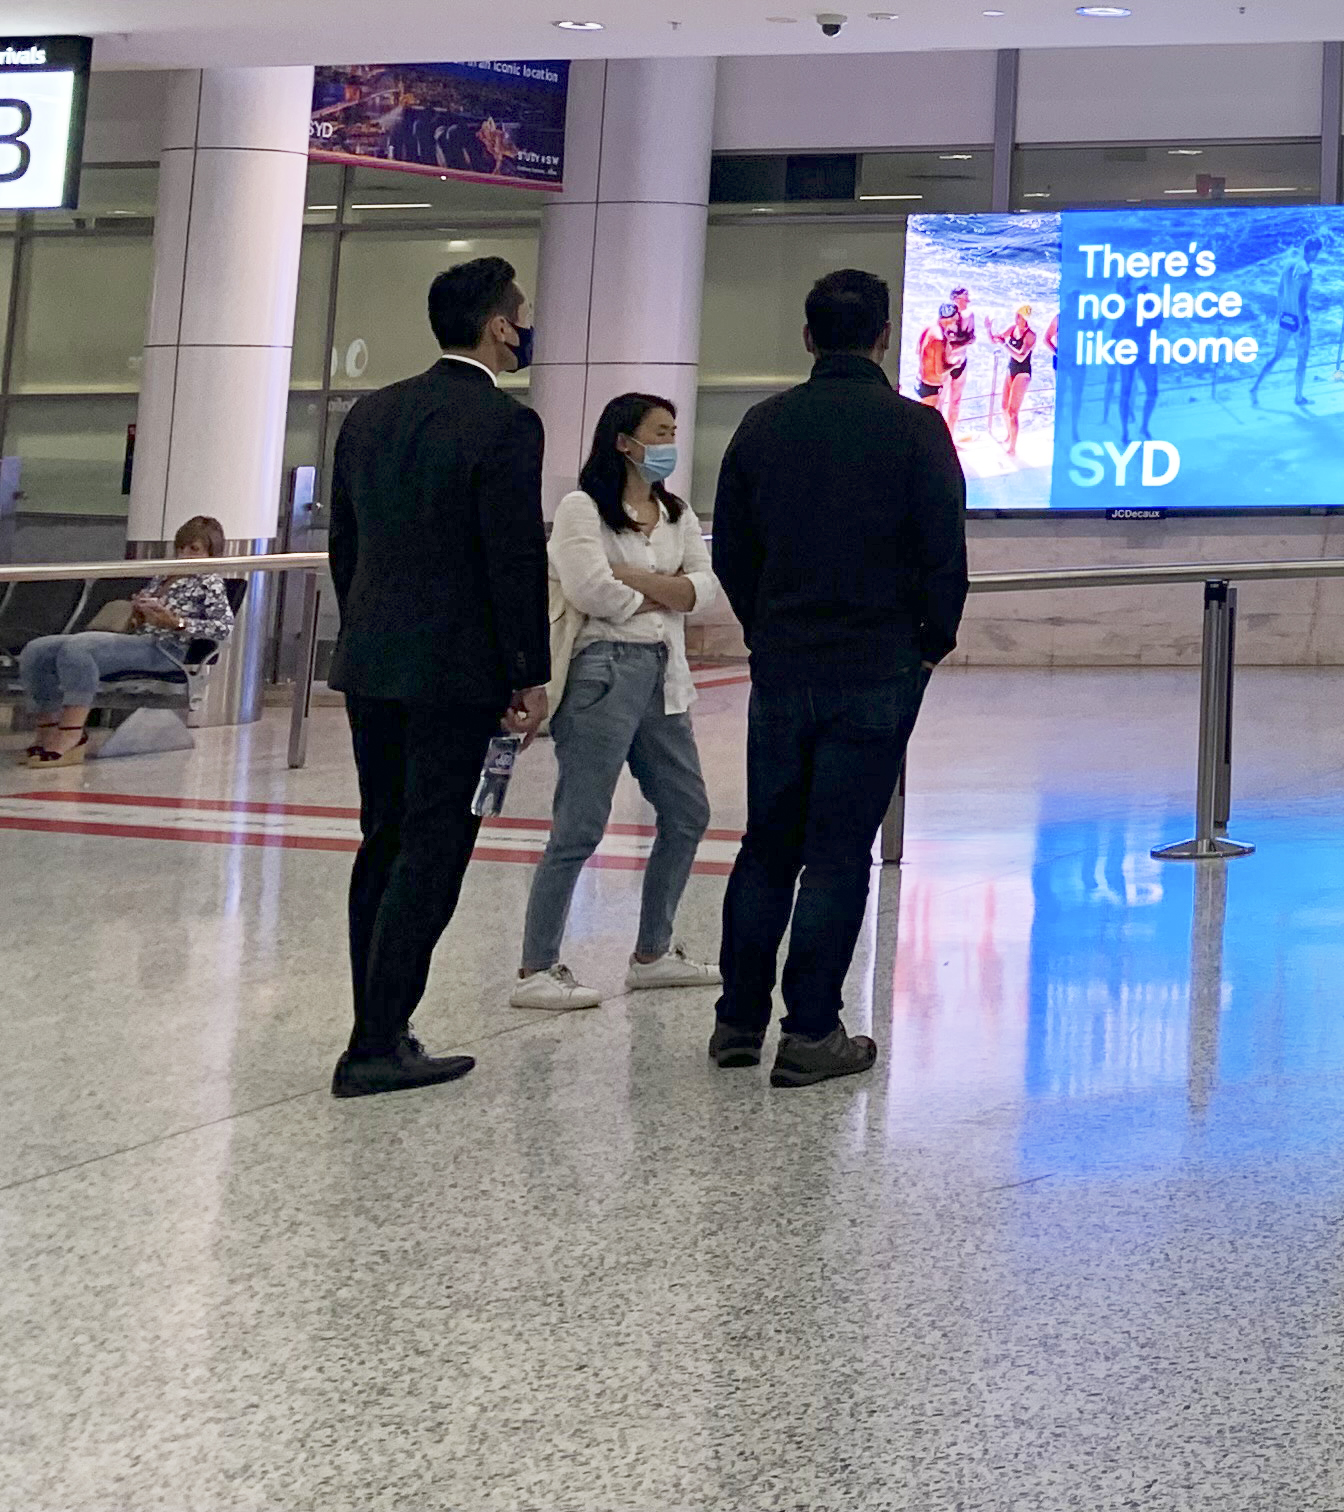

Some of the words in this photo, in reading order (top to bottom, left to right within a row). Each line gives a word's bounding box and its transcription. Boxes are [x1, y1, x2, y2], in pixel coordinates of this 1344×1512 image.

[0, 46, 47, 64] rivals
[523, 64, 558, 83] location
[1078, 241, 1216, 279] There's
[1077, 291, 1126, 320] no
[1136, 283, 1242, 326] place
[1076, 332, 1138, 365] like
[1149, 329, 1259, 364] home
[1068, 440, 1181, 488] SYD
[1111, 509, 1161, 518] JCDecaux
